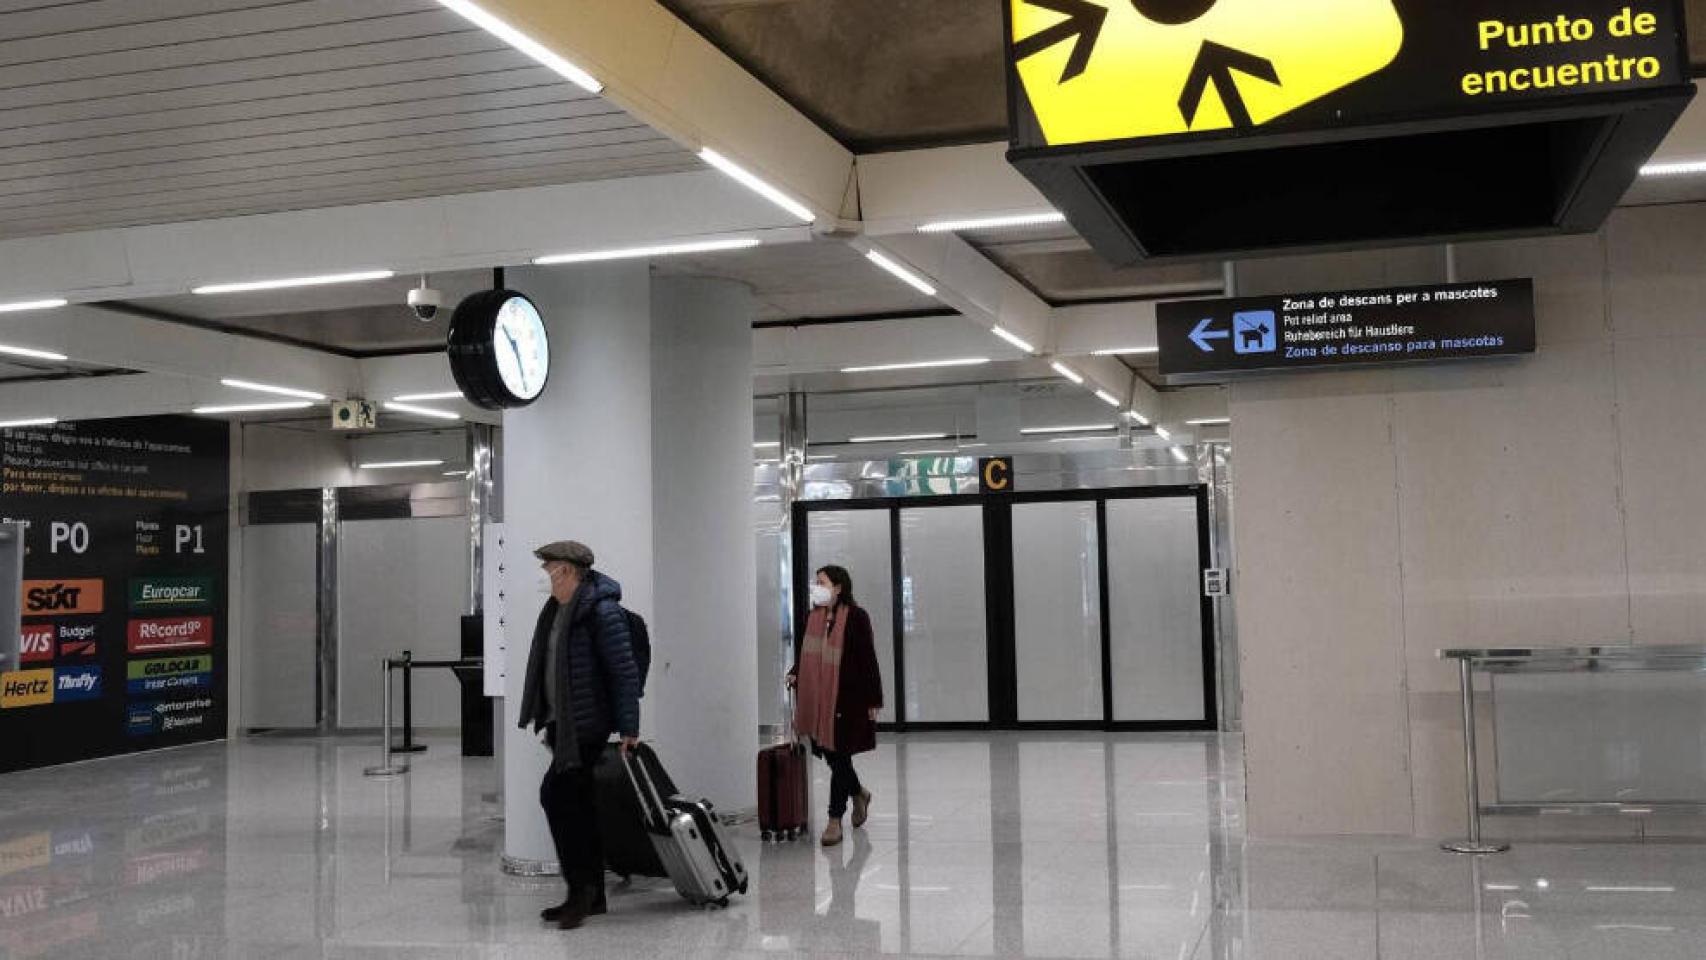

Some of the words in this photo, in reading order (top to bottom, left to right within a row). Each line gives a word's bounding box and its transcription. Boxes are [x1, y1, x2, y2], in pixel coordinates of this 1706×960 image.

[1478, 15, 1594, 50] Punto
[1608, 7, 1657, 37] de
[1461, 54, 1660, 96] encuentro
[1282, 298, 1315, 311] Zona
[1318, 296, 1335, 308] de
[1339, 295, 1393, 307] descans
[1396, 293, 1418, 305] per
[1422, 292, 1431, 302] a
[1434, 286, 1498, 301] mascotes
[1301, 312, 1327, 325] relief
[1329, 314, 1353, 324] area
[1365, 323, 1415, 337] Haustiere
[1285, 346, 1317, 358] Zona
[1321, 345, 1338, 355] de
[1341, 343, 1403, 355] descanso
[1406, 340, 1436, 353] para
[1441, 335, 1505, 348] mascotas
[985, 460, 1008, 489] C
[51, 522, 89, 553] P0
[175, 524, 205, 553] P1
[142, 584, 201, 602] Europcar
[20, 633, 52, 653] VIS
[60, 624, 94, 640] Budget
[4, 679, 48, 696] Hertz
